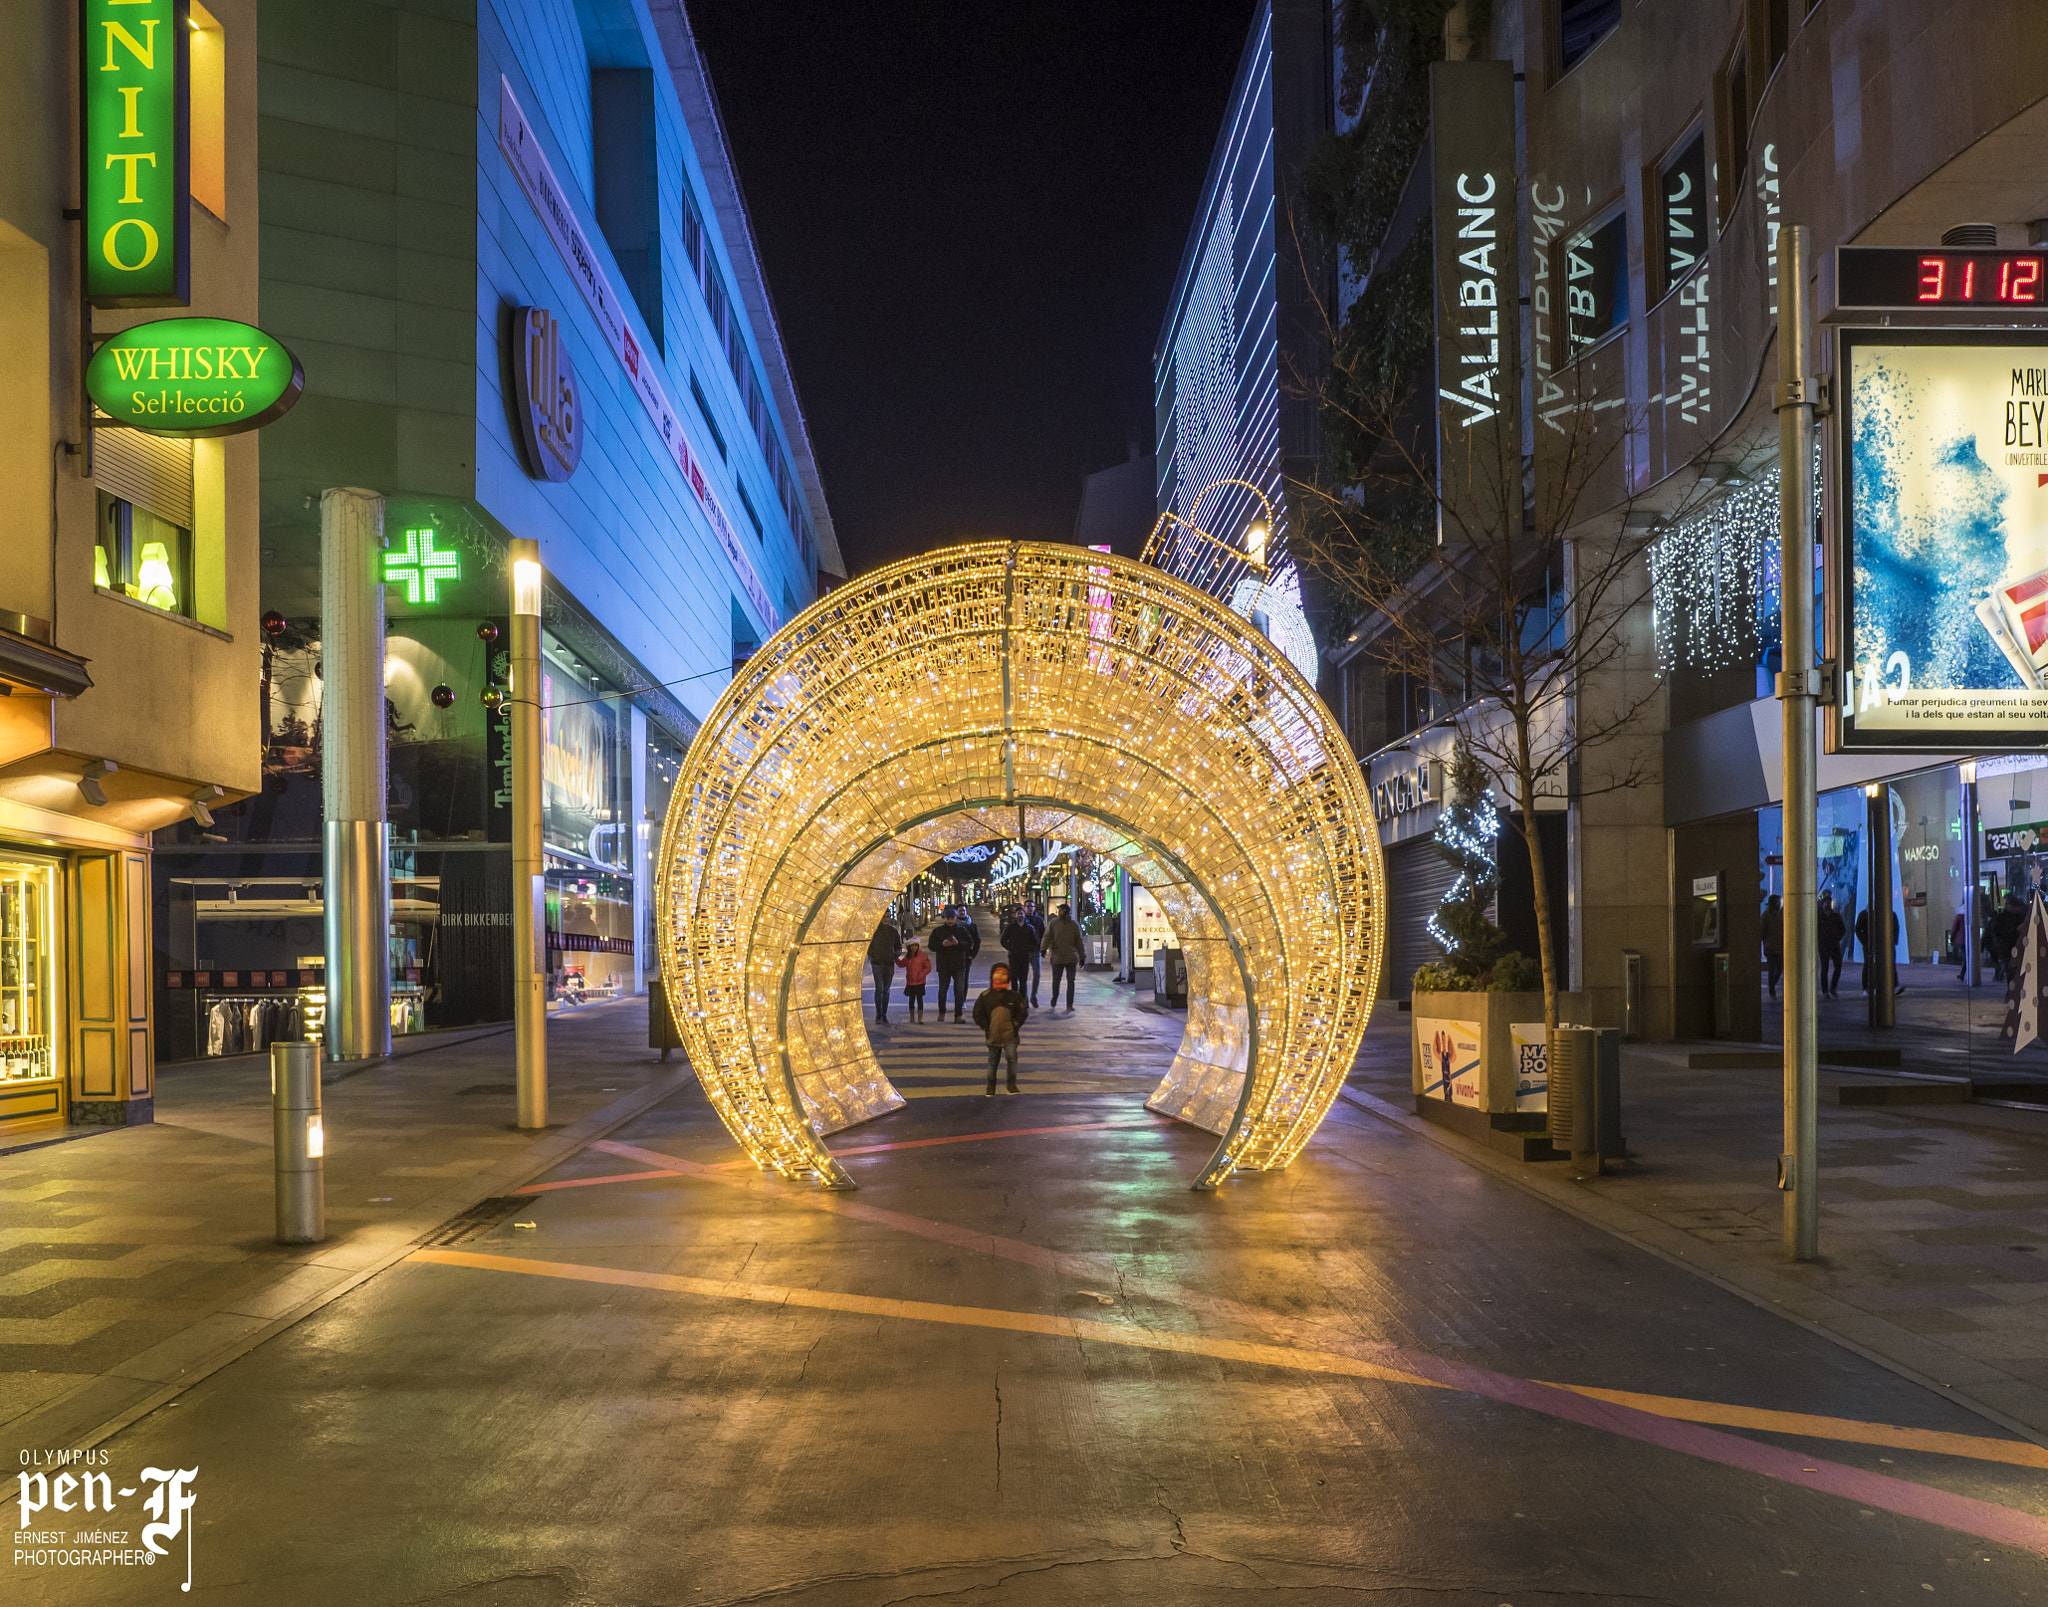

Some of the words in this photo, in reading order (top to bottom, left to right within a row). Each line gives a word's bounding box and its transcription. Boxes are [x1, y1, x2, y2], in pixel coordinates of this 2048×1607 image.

[100, 0, 160, 271] NITO
[2001, 260, 2038, 300] 12
[1439, 172, 1500, 427] VALLBANC
[110, 347, 268, 381] WHISKY
[2005, 400, 2048, 448] BEY
[1905, 710, 1909, 718] i
[1911, 710, 1920, 718] la
[1923, 710, 1943, 718] dels
[1946, 712, 1964, 720] que
[1997, 710, 2005, 718] al
[1921, 697, 1967, 708] perjudica
[1970, 698, 2017, 708] greument
[2019, 697, 2028, 706] la
[441, 913, 463, 927] DIRK
